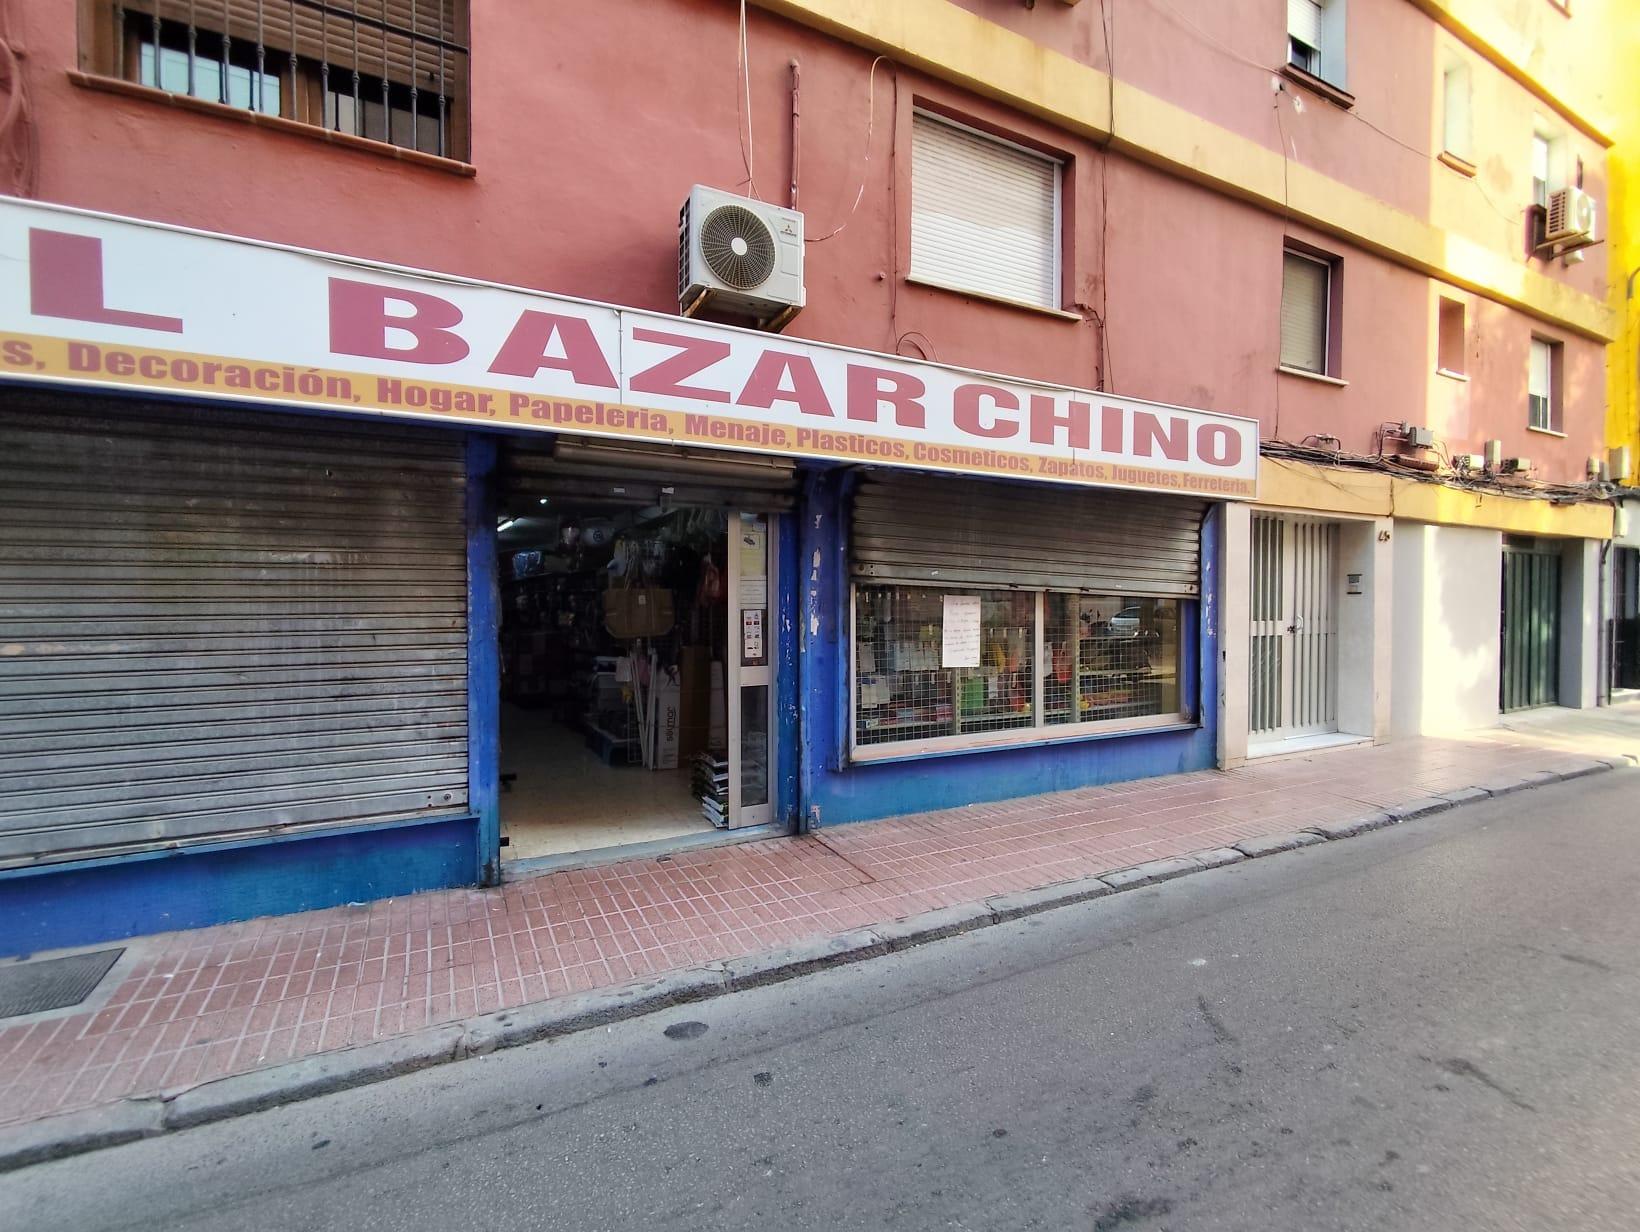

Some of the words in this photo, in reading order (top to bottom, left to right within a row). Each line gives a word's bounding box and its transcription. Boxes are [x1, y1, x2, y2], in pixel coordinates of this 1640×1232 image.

[29, 226, 184, 334] L
[328, 276, 926, 429] BAZAR
[953, 383, 1242, 467] CHINO
[68, 341, 361, 403] Decoración,
[377, 377, 496, 416] Hogar,
[685, 412, 792, 448] Menaje,
[796, 427, 909, 461] Plasticos,
[913, 441, 1033, 473] Cosmeticos,
[1038, 455, 1108, 481] Zapatos,
[1112, 463, 1181, 489] Juguetes,
